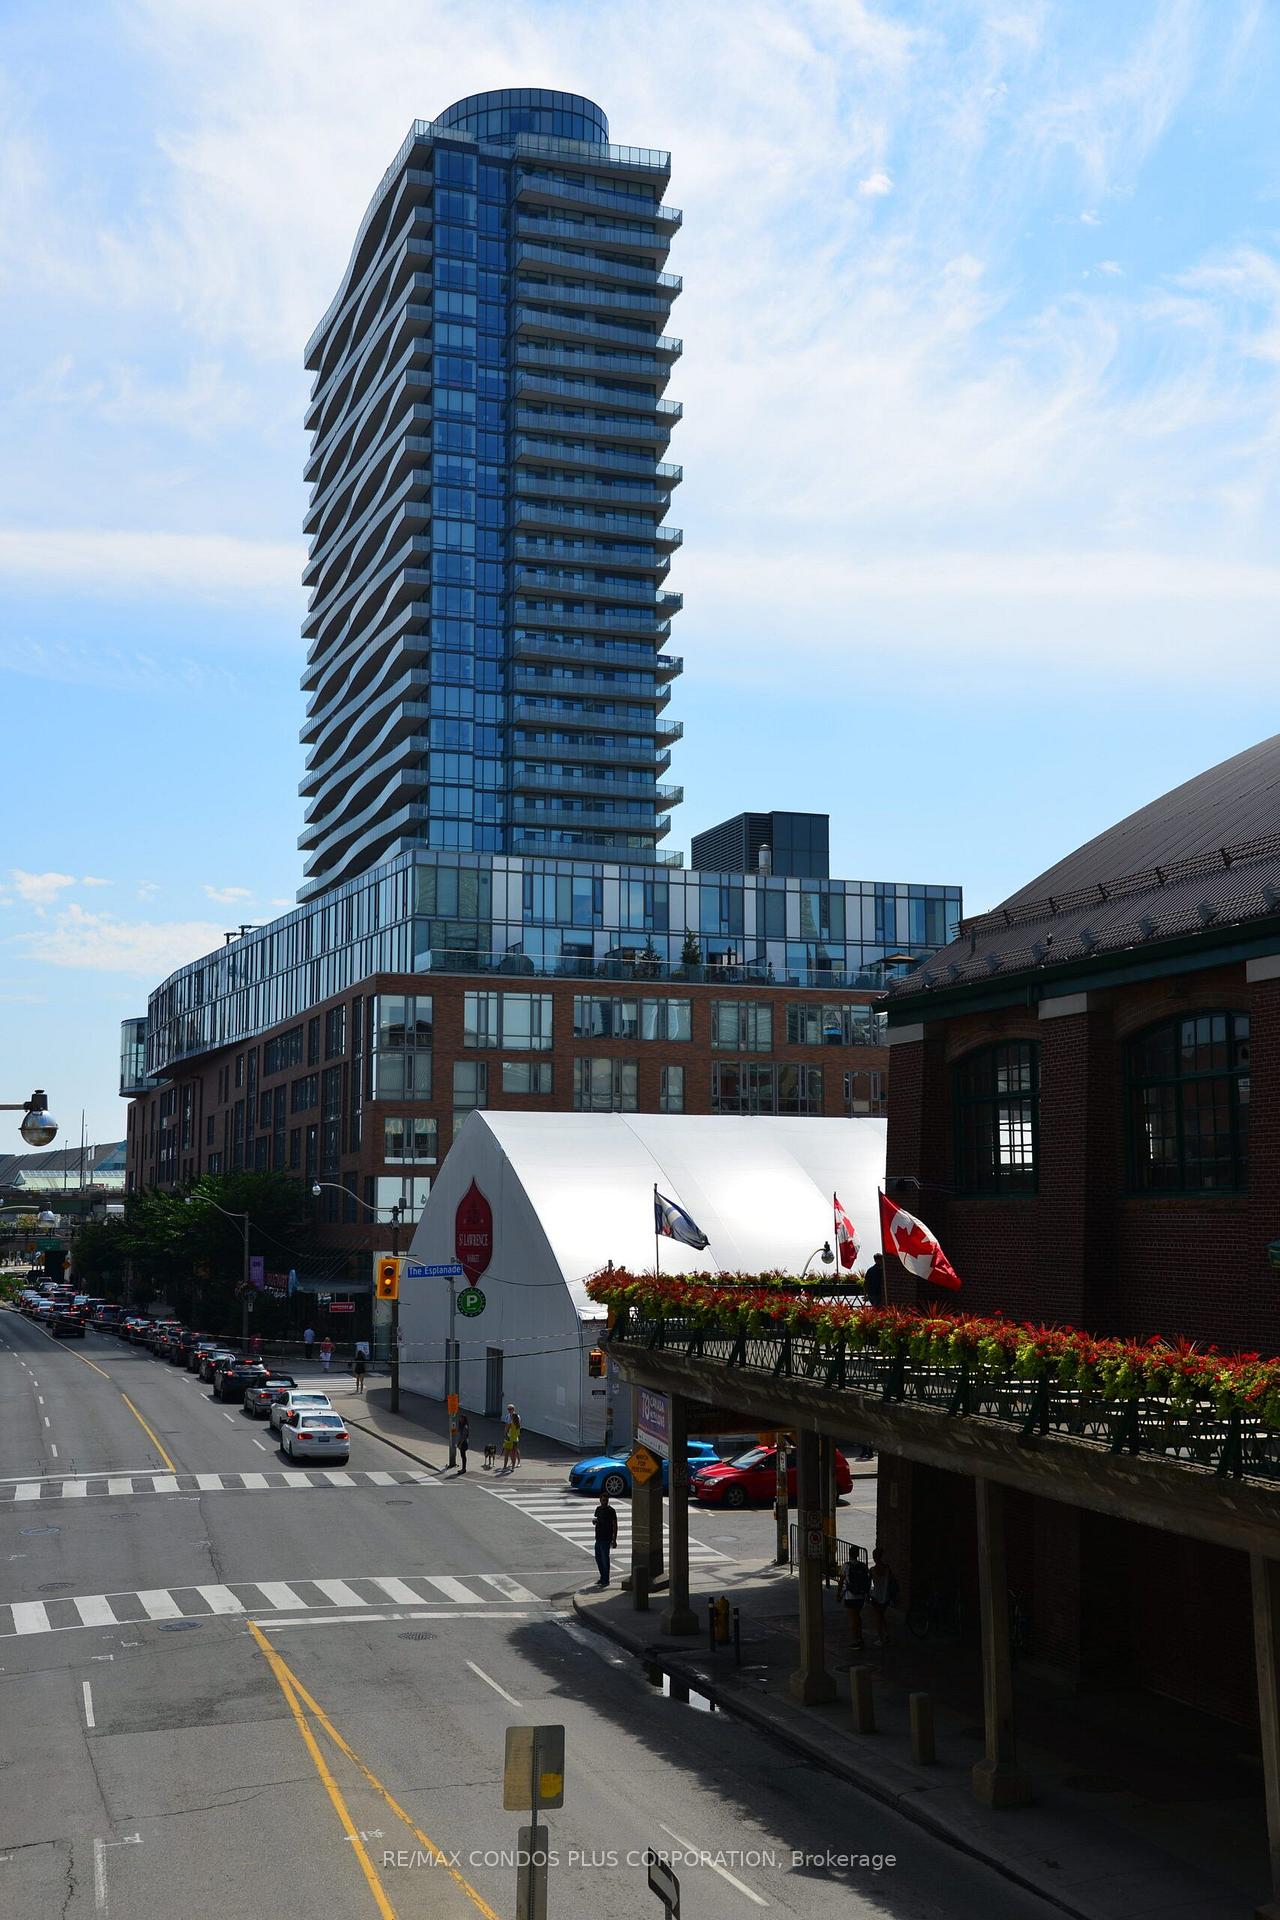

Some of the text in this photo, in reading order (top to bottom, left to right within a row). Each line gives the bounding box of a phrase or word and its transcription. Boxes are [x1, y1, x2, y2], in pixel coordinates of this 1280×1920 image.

[463, 1233, 488, 1246] LAWRENCE
[409, 1265, 461, 1276] The Esplanade
[466, 1295, 477, 1307] P
